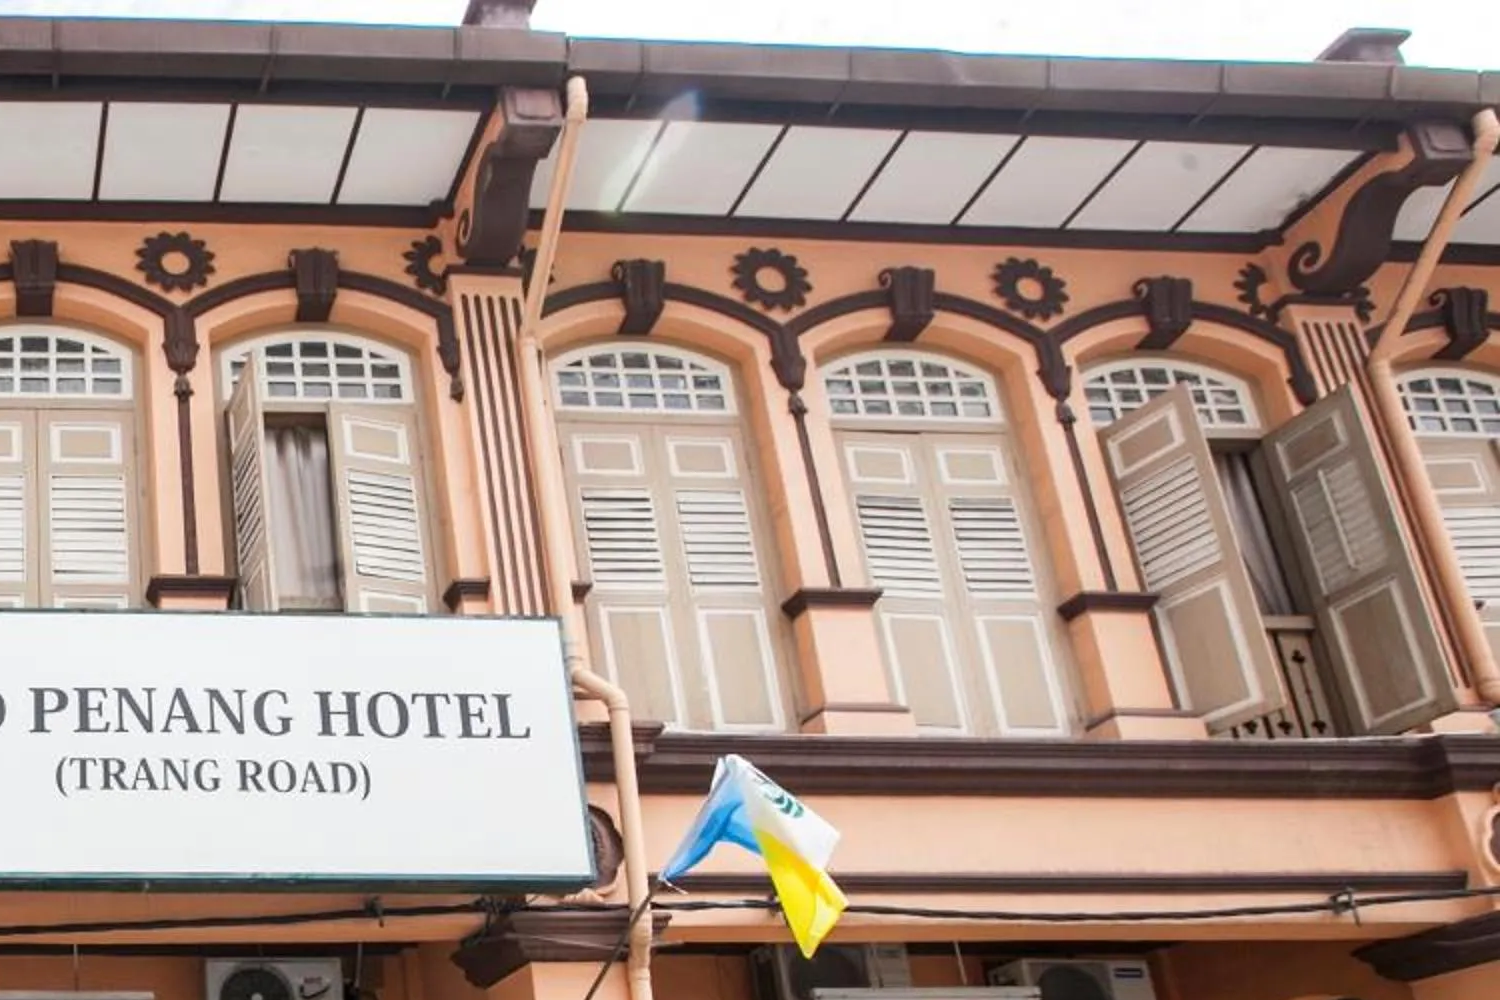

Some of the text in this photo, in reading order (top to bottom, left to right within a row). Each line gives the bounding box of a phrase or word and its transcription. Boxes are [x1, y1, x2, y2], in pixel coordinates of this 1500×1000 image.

[28, 687, 294, 737] PENANG
[313, 690, 532, 739] HOTEL
[54, 756, 372, 801] (TRANG ROAD)
